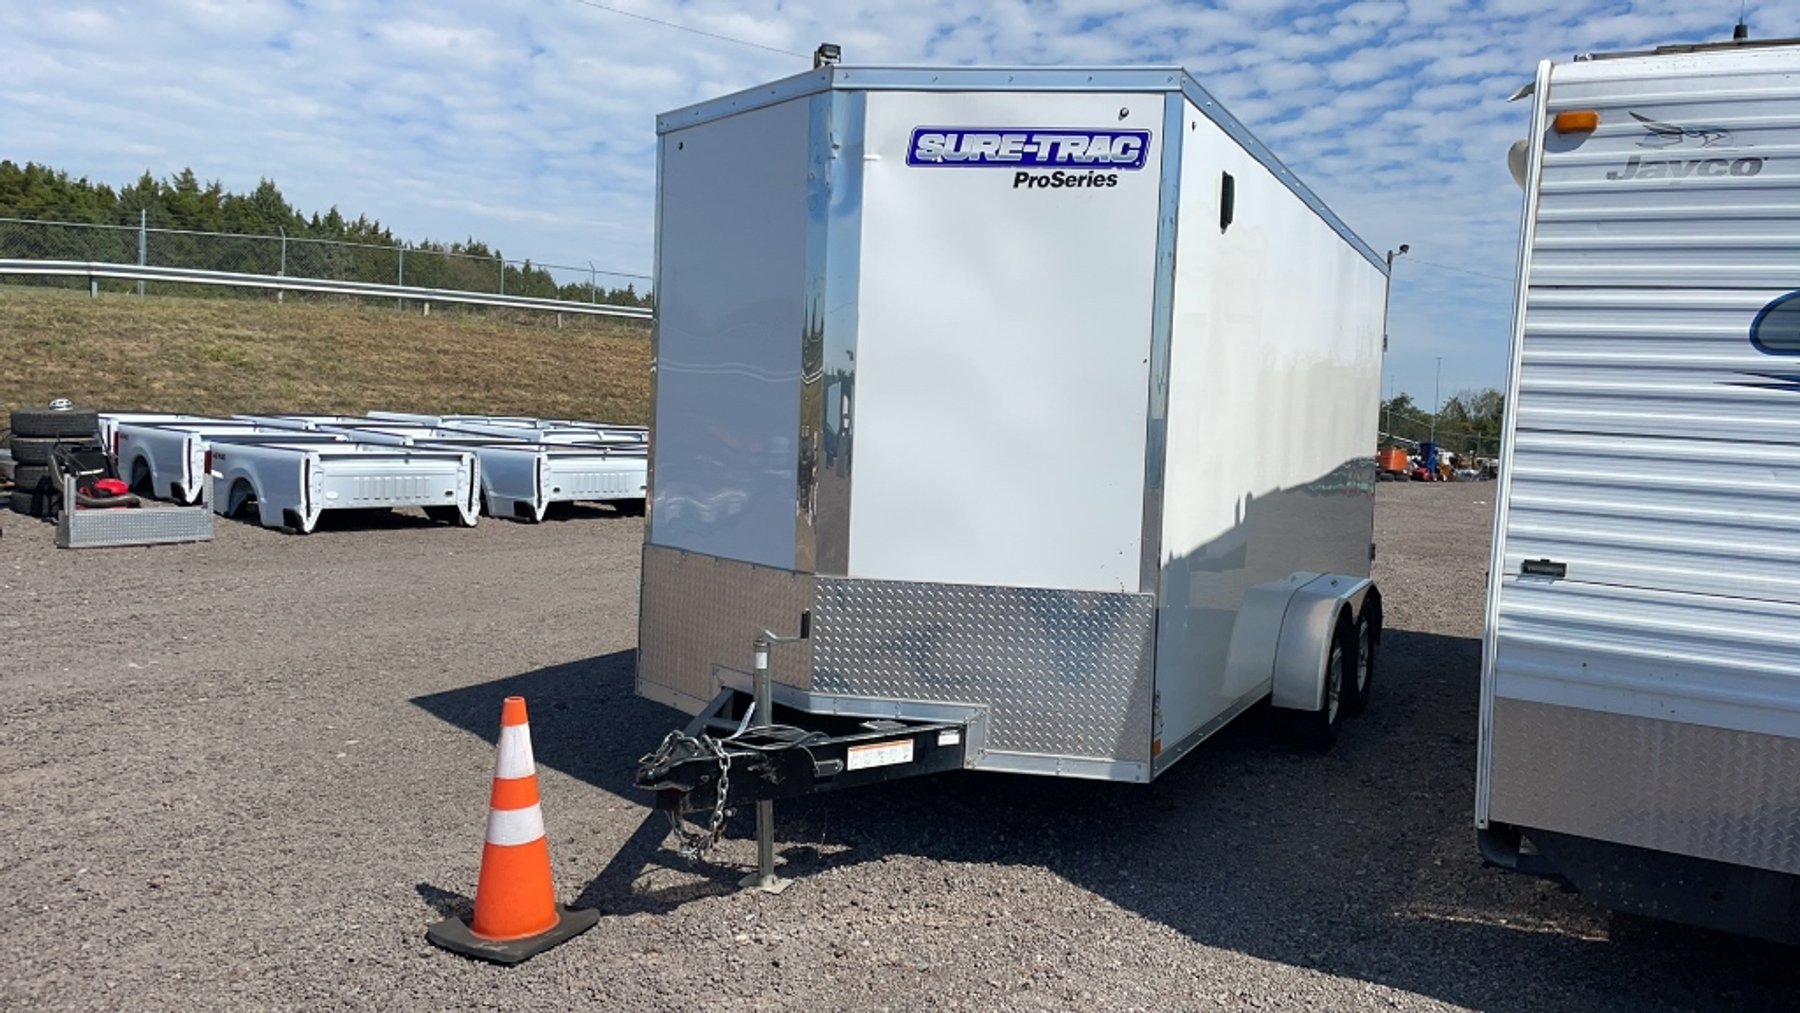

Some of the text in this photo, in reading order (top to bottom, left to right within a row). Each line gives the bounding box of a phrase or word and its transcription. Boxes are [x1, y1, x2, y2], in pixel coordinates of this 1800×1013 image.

[915, 133, 1141, 163] SURE-TRAC
[1013, 171, 1118, 189] ProSeries
[1606, 156, 1763, 184] Jayco
